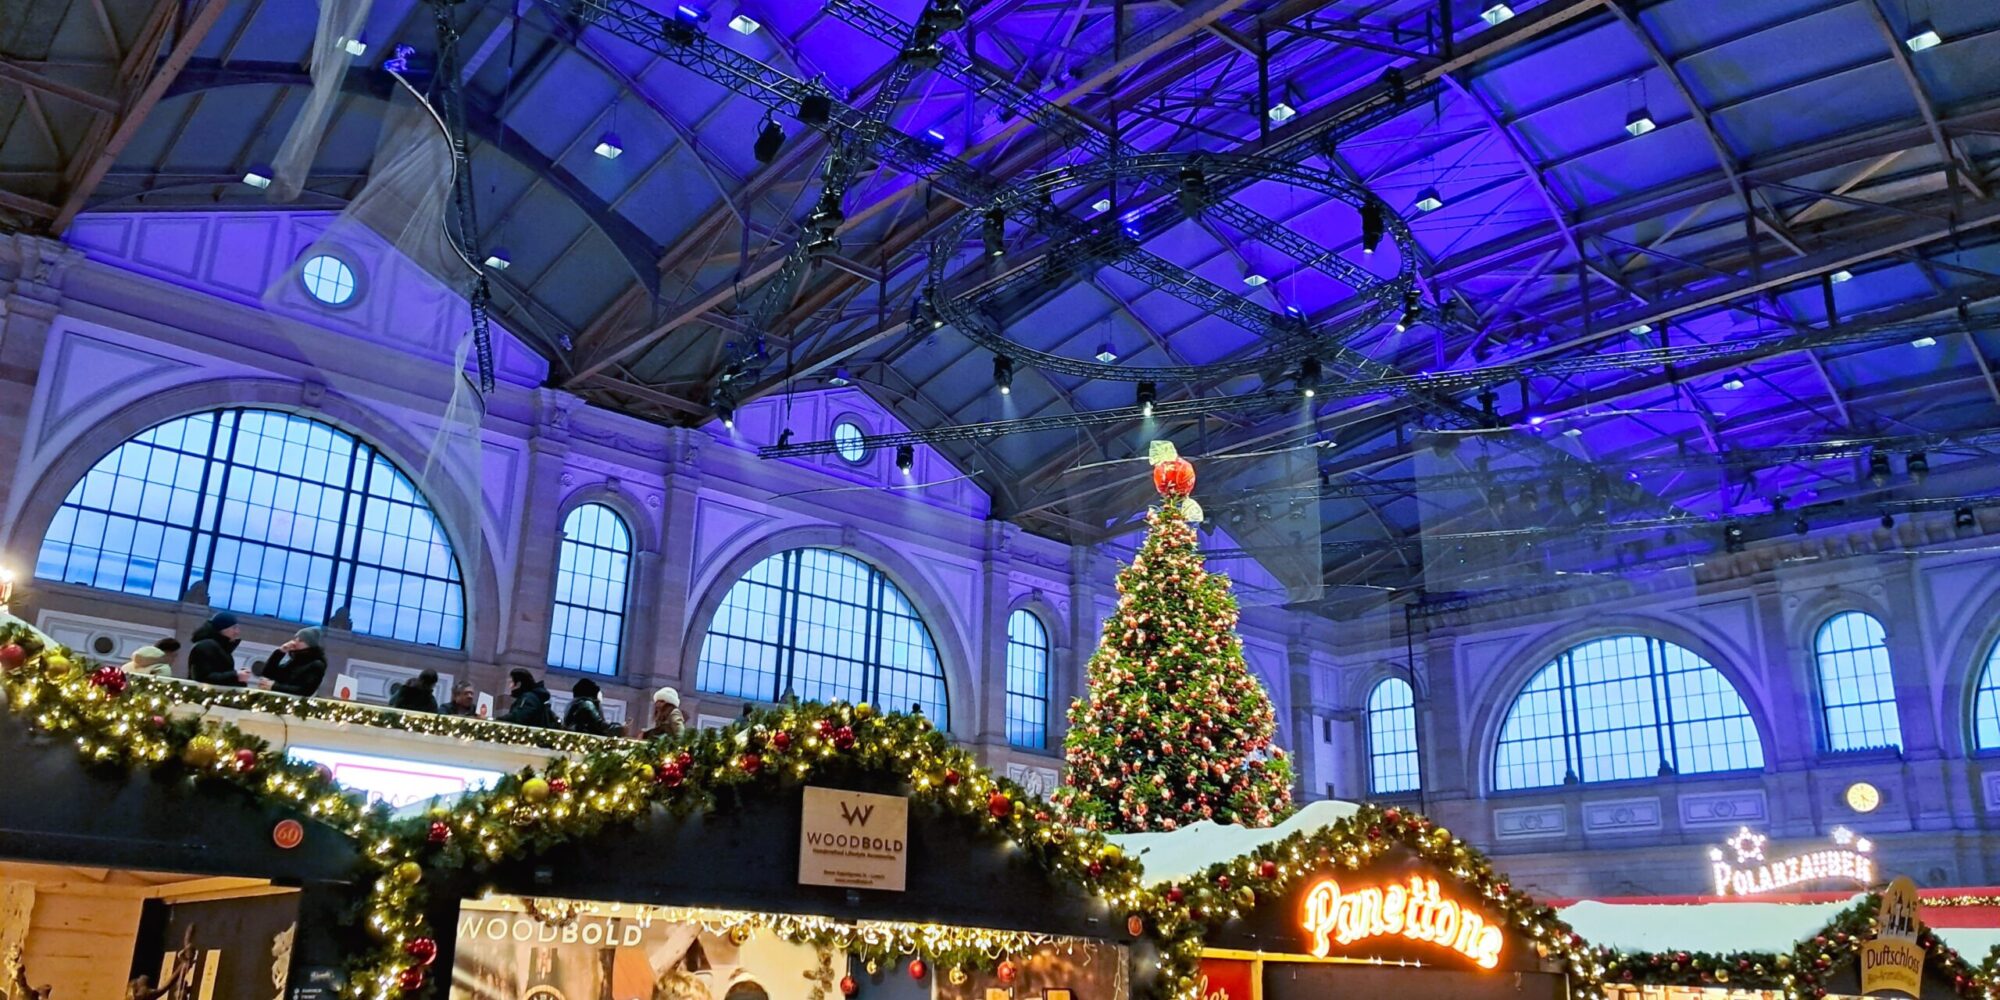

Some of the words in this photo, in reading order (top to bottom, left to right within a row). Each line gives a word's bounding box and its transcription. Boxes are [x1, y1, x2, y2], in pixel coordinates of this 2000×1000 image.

[807, 832, 903, 852] WOODBOLD
[457, 915, 643, 947] WOODBOLD
[1303, 876, 1504, 970] Panettone
[1867, 945, 1920, 974] Duftschloss
